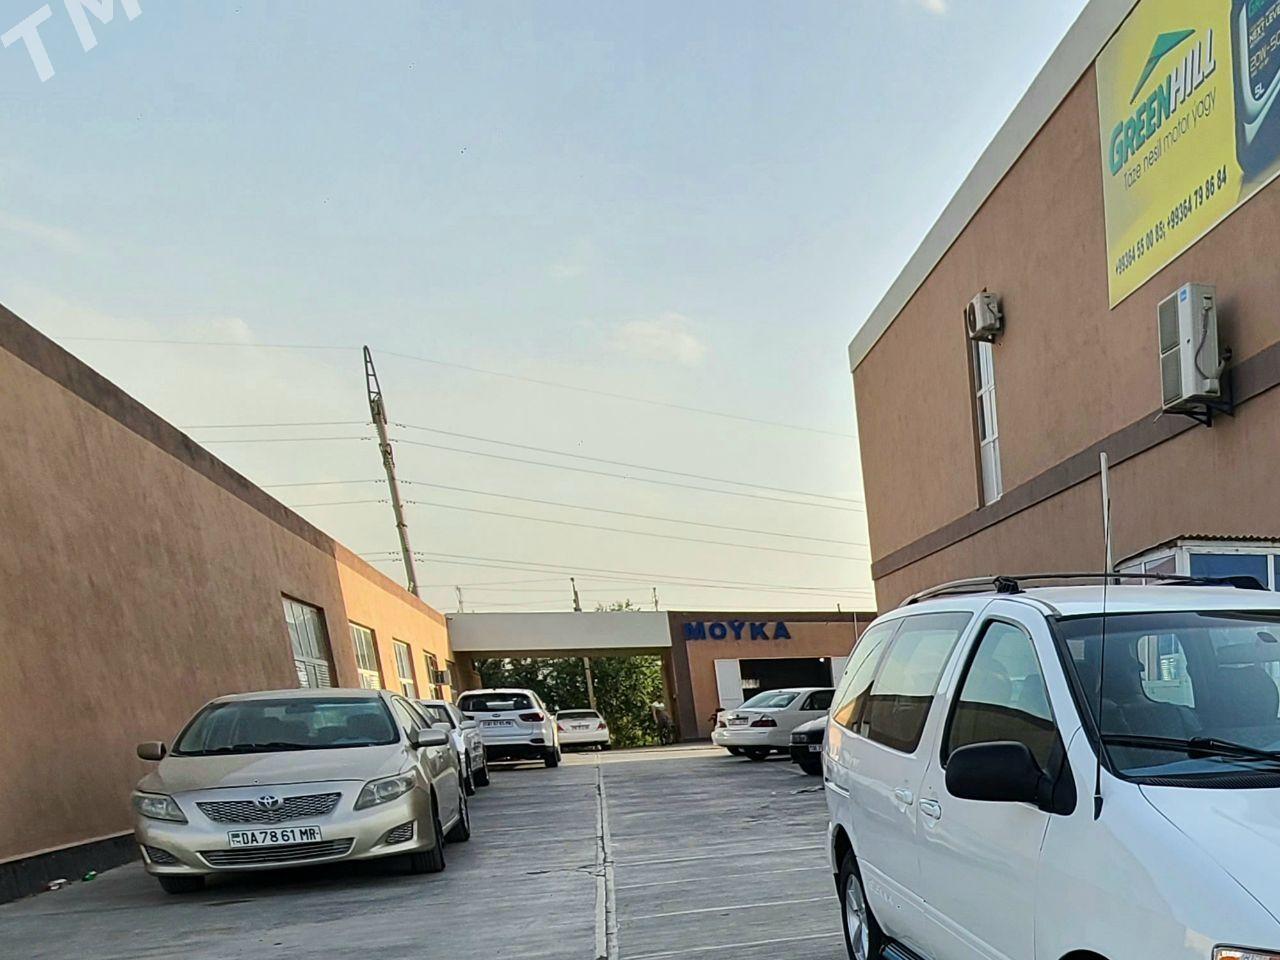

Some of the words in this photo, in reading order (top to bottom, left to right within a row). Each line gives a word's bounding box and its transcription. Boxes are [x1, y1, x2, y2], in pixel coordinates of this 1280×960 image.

[1109, 28, 1216, 176] GREENHILL
[1143, 139, 1162, 169] nesil
[1164, 114, 1190, 152] motor
[1136, 237, 1144, 259] 55
[1167, 195, 1192, 230] +99364
[1194, 186, 1203, 210] 79
[1205, 175, 1214, 200] 86
[1217, 165, 1226, 191] 84
[259, 830, 279, 843] 78
[281, 829, 297, 842] 61
[299, 828, 317, 841] MR
